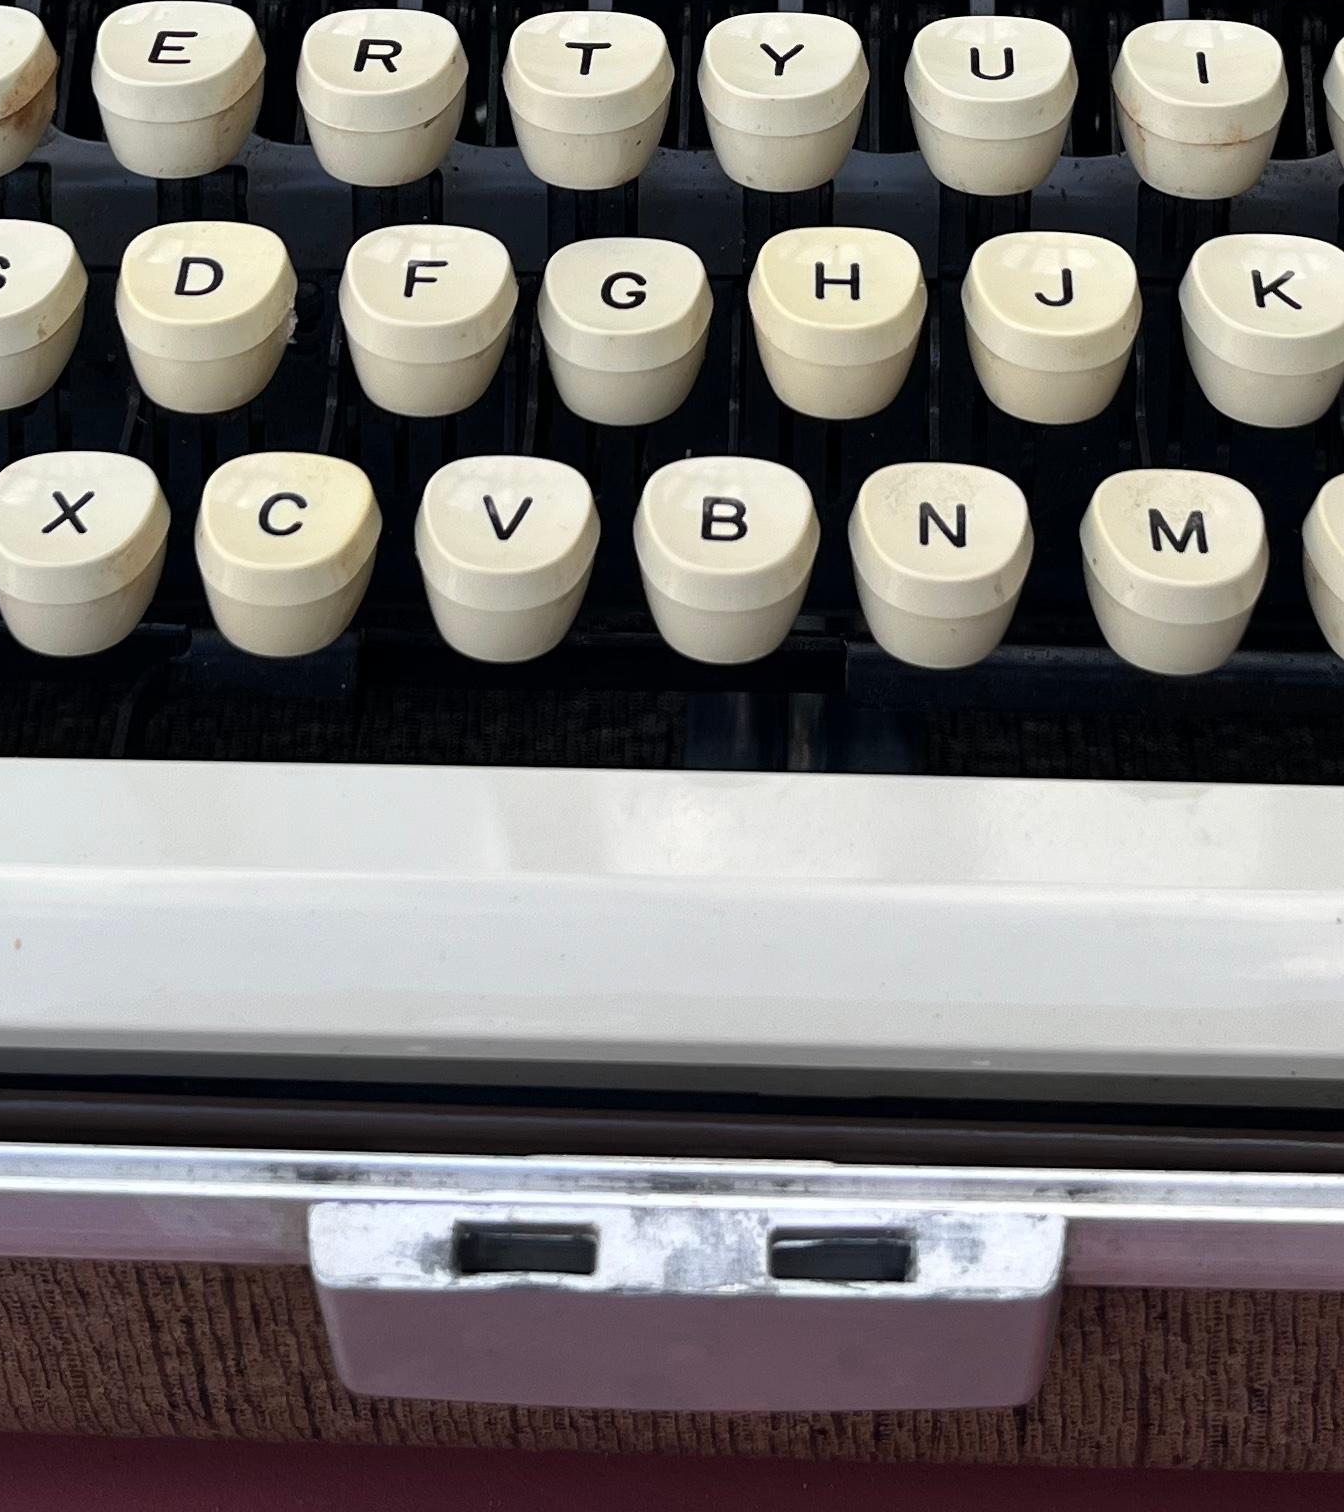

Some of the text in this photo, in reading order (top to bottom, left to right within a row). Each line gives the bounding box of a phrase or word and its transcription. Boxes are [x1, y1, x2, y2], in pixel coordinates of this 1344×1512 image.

[147, 30, 199, 65] E
[353, 38, 403, 73] R
[564, 41, 613, 76] T
[759, 43, 805, 77] Y
[969, 47, 1015, 81] U
[1196, 51, 1210, 85] I
[174, 256, 224, 297] D
[403, 260, 449, 298] F
[600, 271, 647, 310] G
[816, 263, 860, 300] H
[1034, 267, 1074, 307] J
[1251, 269, 1303, 310] K
[41, 491, 95, 534] X
[258, 492, 308, 537] C
[482, 495, 533, 541] V
[700, 496, 748, 542] B
[919, 502, 967, 549] N
[1148, 508, 1209, 554] M
